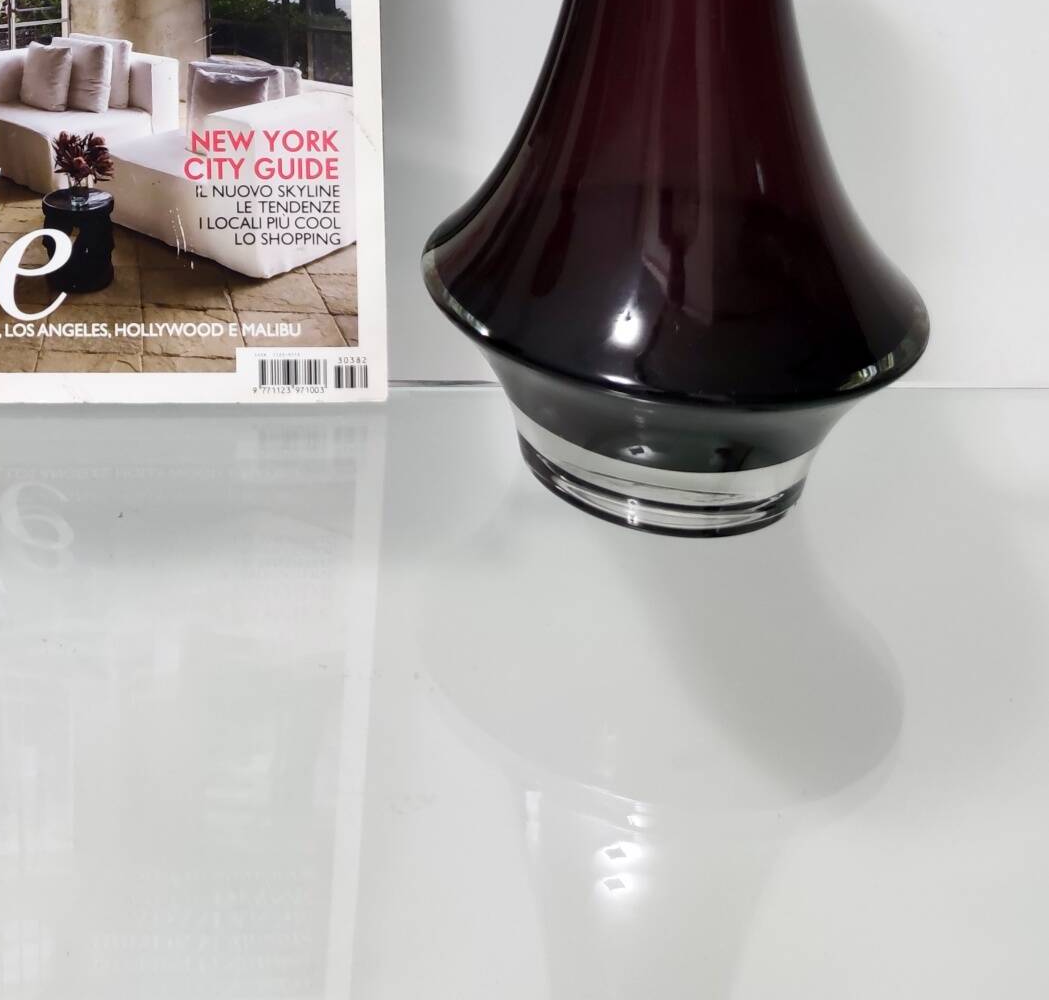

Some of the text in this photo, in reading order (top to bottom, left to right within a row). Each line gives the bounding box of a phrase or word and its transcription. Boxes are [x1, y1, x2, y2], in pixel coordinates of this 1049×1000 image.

[192, 130, 339, 153] NEW YORK
[184, 158, 339, 180] CITY GUIDE
[213, 186, 273, 198] NUOVO
[278, 185, 340, 198] SKYLINE
[237, 201, 340, 214] LE TENDENZE
[207, 217, 262, 230] LOCALI
[266, 214, 290, 229] PIÙ
[294, 217, 341, 230] COOL
[235, 232, 341, 246] LO SHOPPING
[5, 324, 35, 337] LOS
[38, 324, 112, 339] ANGELES,
[115, 324, 223, 337] HOLLYWOOD
[229, 324, 237, 337] E
[242, 323, 302, 337] MALIBU
